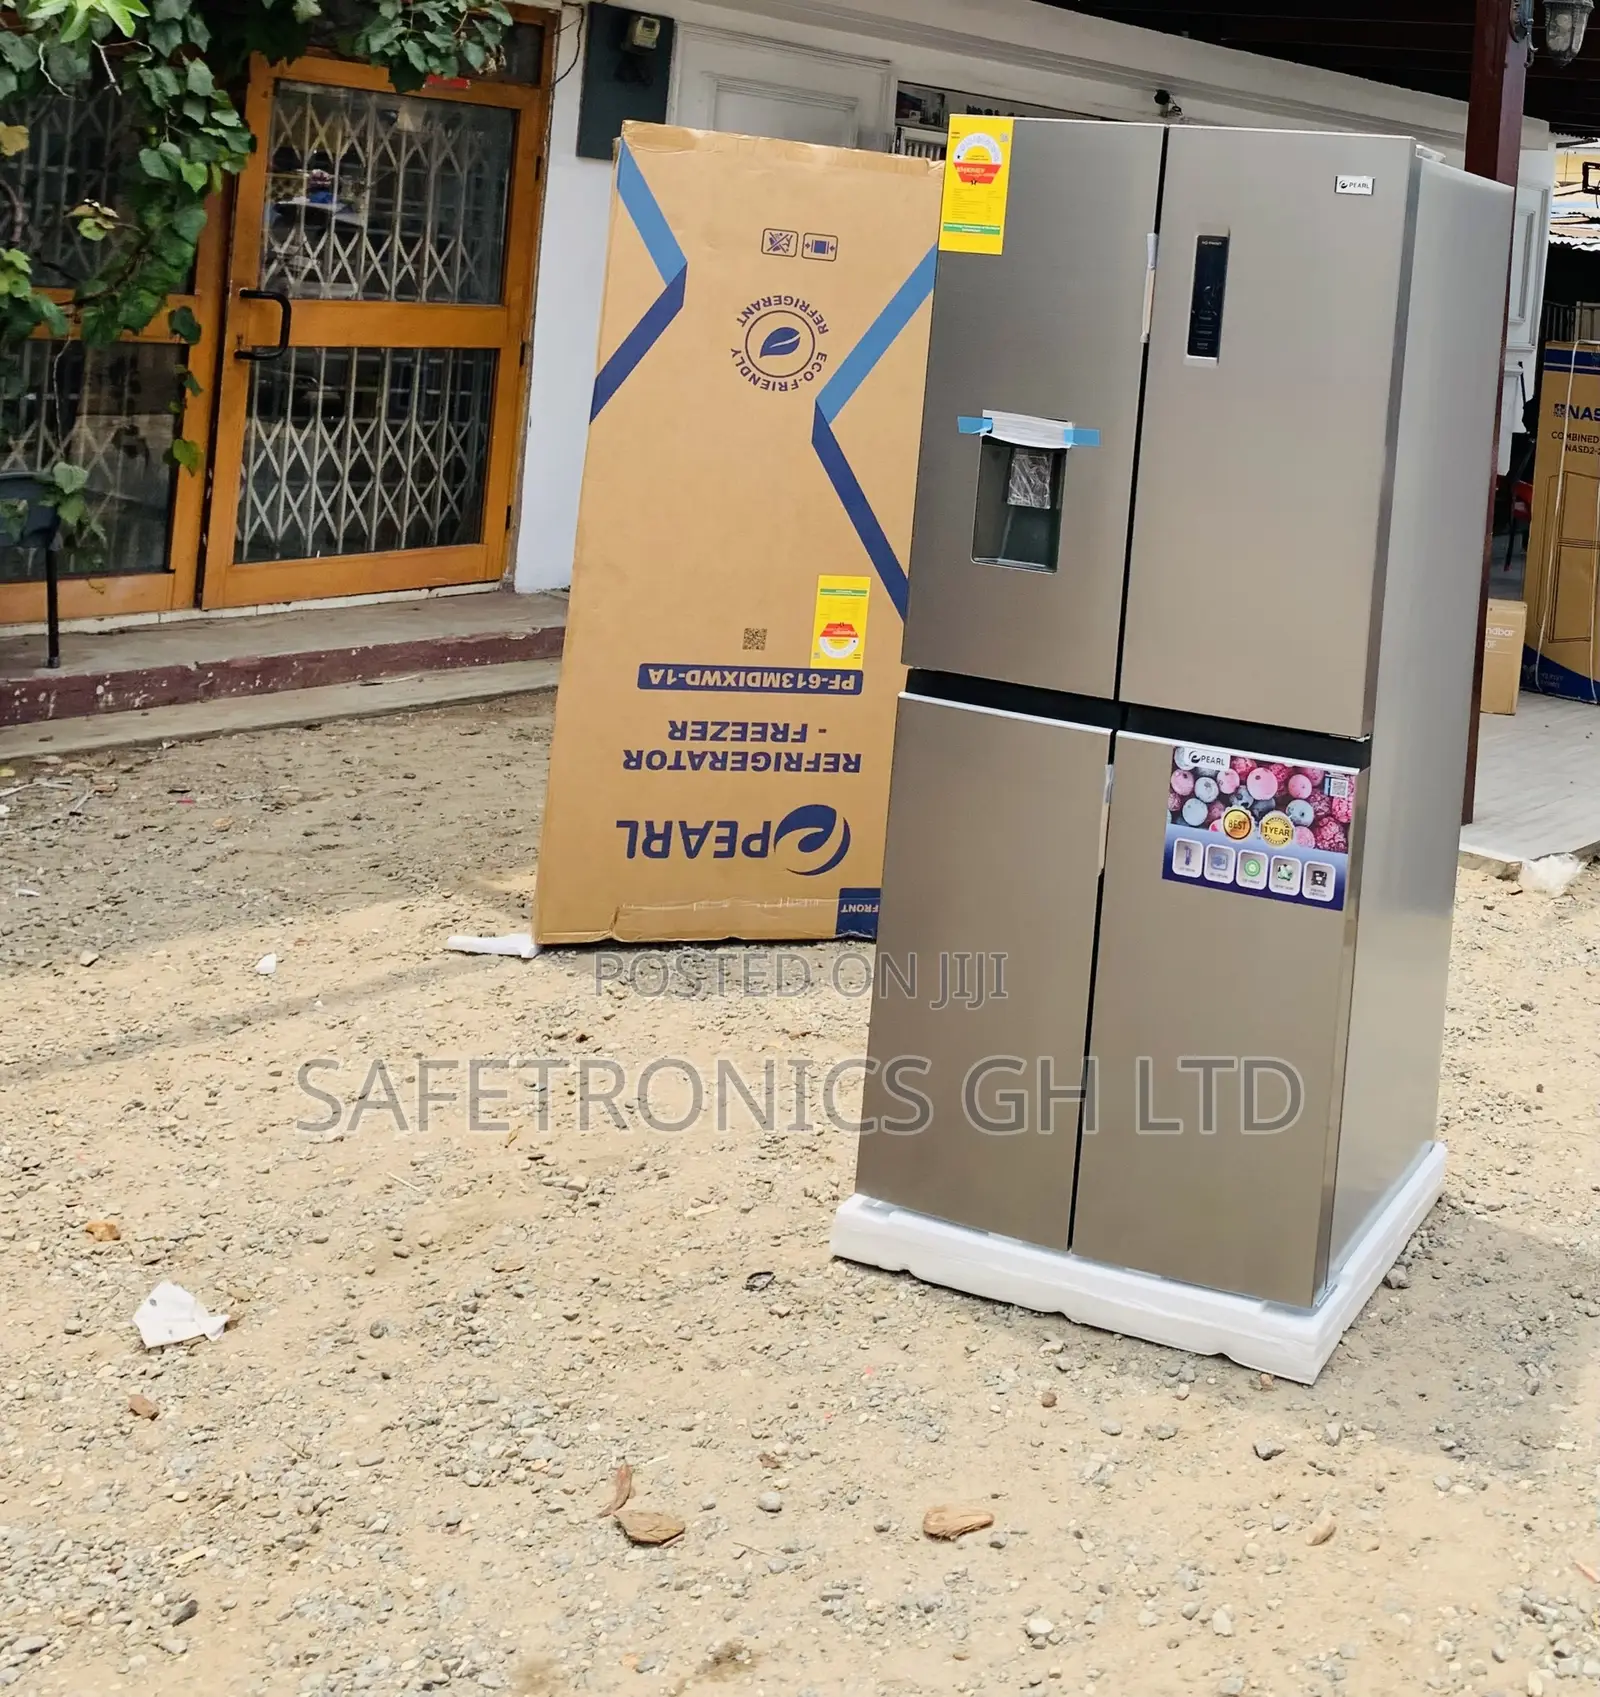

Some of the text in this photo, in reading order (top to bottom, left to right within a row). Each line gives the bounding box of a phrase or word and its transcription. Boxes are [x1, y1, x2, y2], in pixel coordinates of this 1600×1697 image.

[736, 295, 829, 335] REFRIGERANT
[730, 348, 828, 392] ECO-FRIENDLY
[1486, 627, 1515, 636] ndbar
[648, 669, 855, 690] PF-613MDIXWD-1A
[668, 720, 808, 743] FREEZER
[623, 749, 862, 773] REFRIGERATOR
[1201, 755, 1226, 767] PEARL
[1228, 819, 1247, 830] BEST
[1269, 826, 1290, 837] YEAR
[615, 820, 772, 859] PEARL
[840, 904, 879, 913] FRONT
